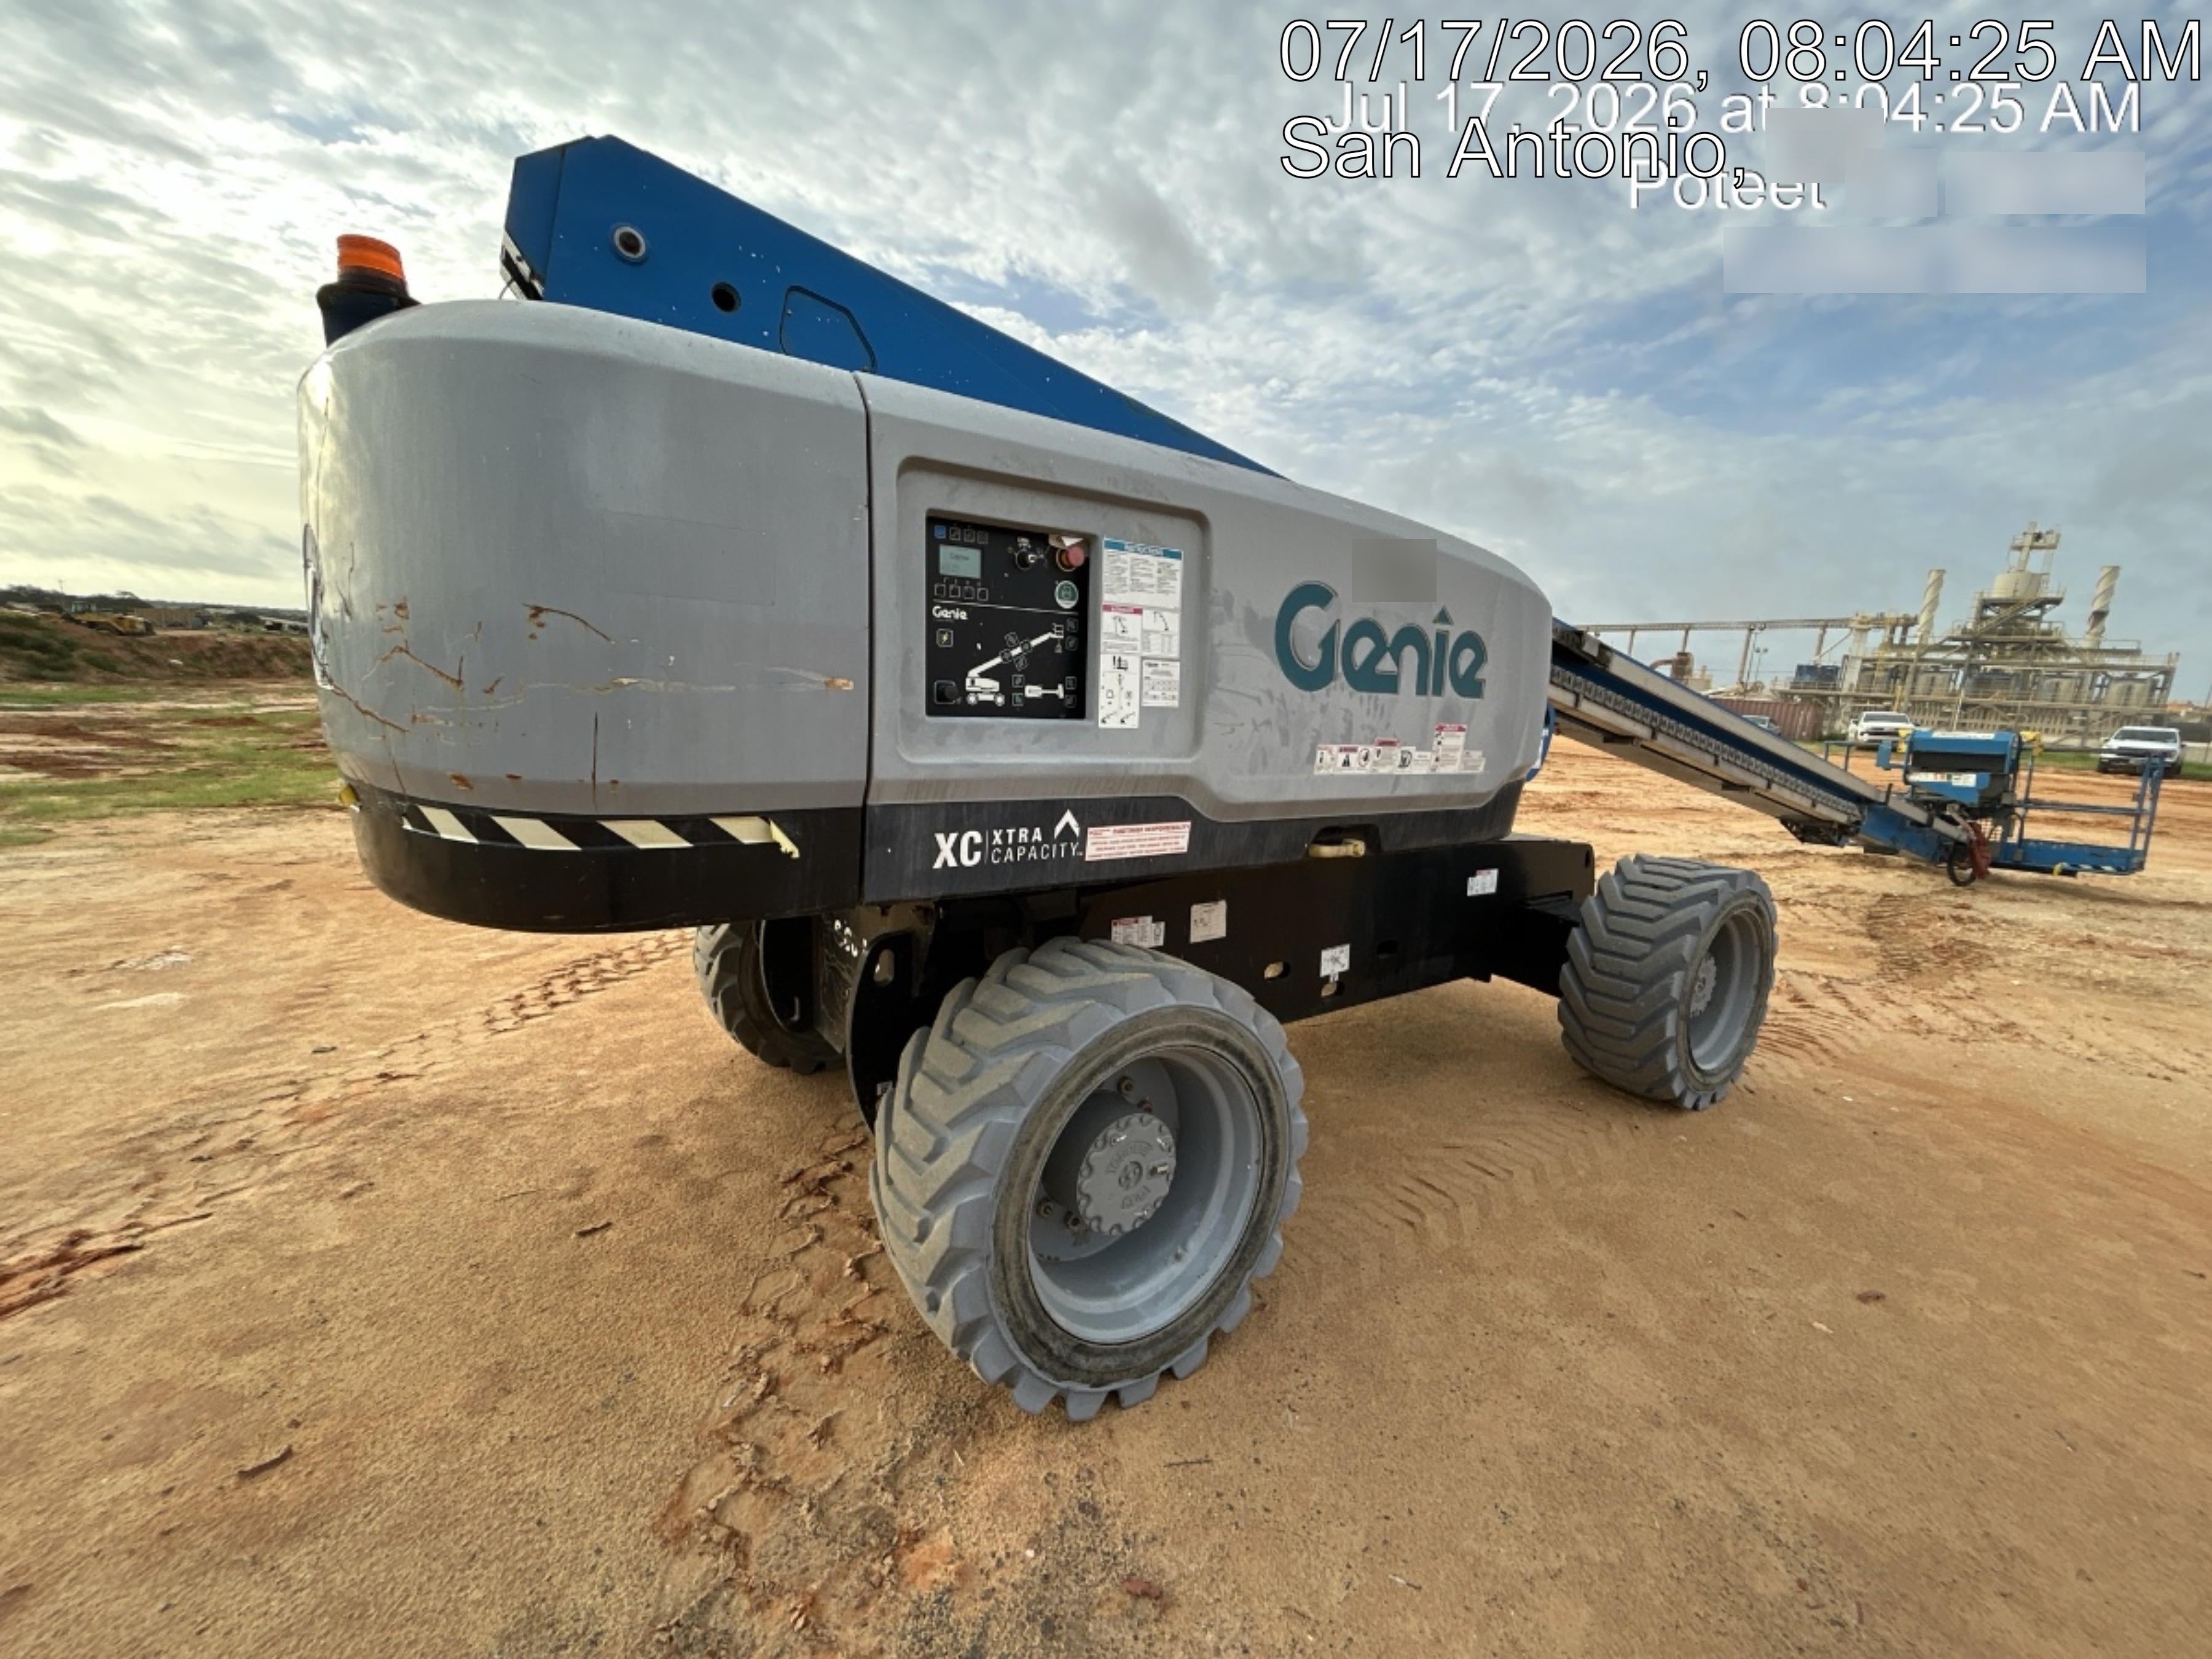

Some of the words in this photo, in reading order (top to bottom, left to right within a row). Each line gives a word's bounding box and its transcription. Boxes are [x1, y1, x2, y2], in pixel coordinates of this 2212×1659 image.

[1274, 580, 1488, 699] Genie
[932, 831, 982, 869] XC
[991, 827, 1042, 845] XTRA
[990, 842, 1079, 864] CAPACITY
